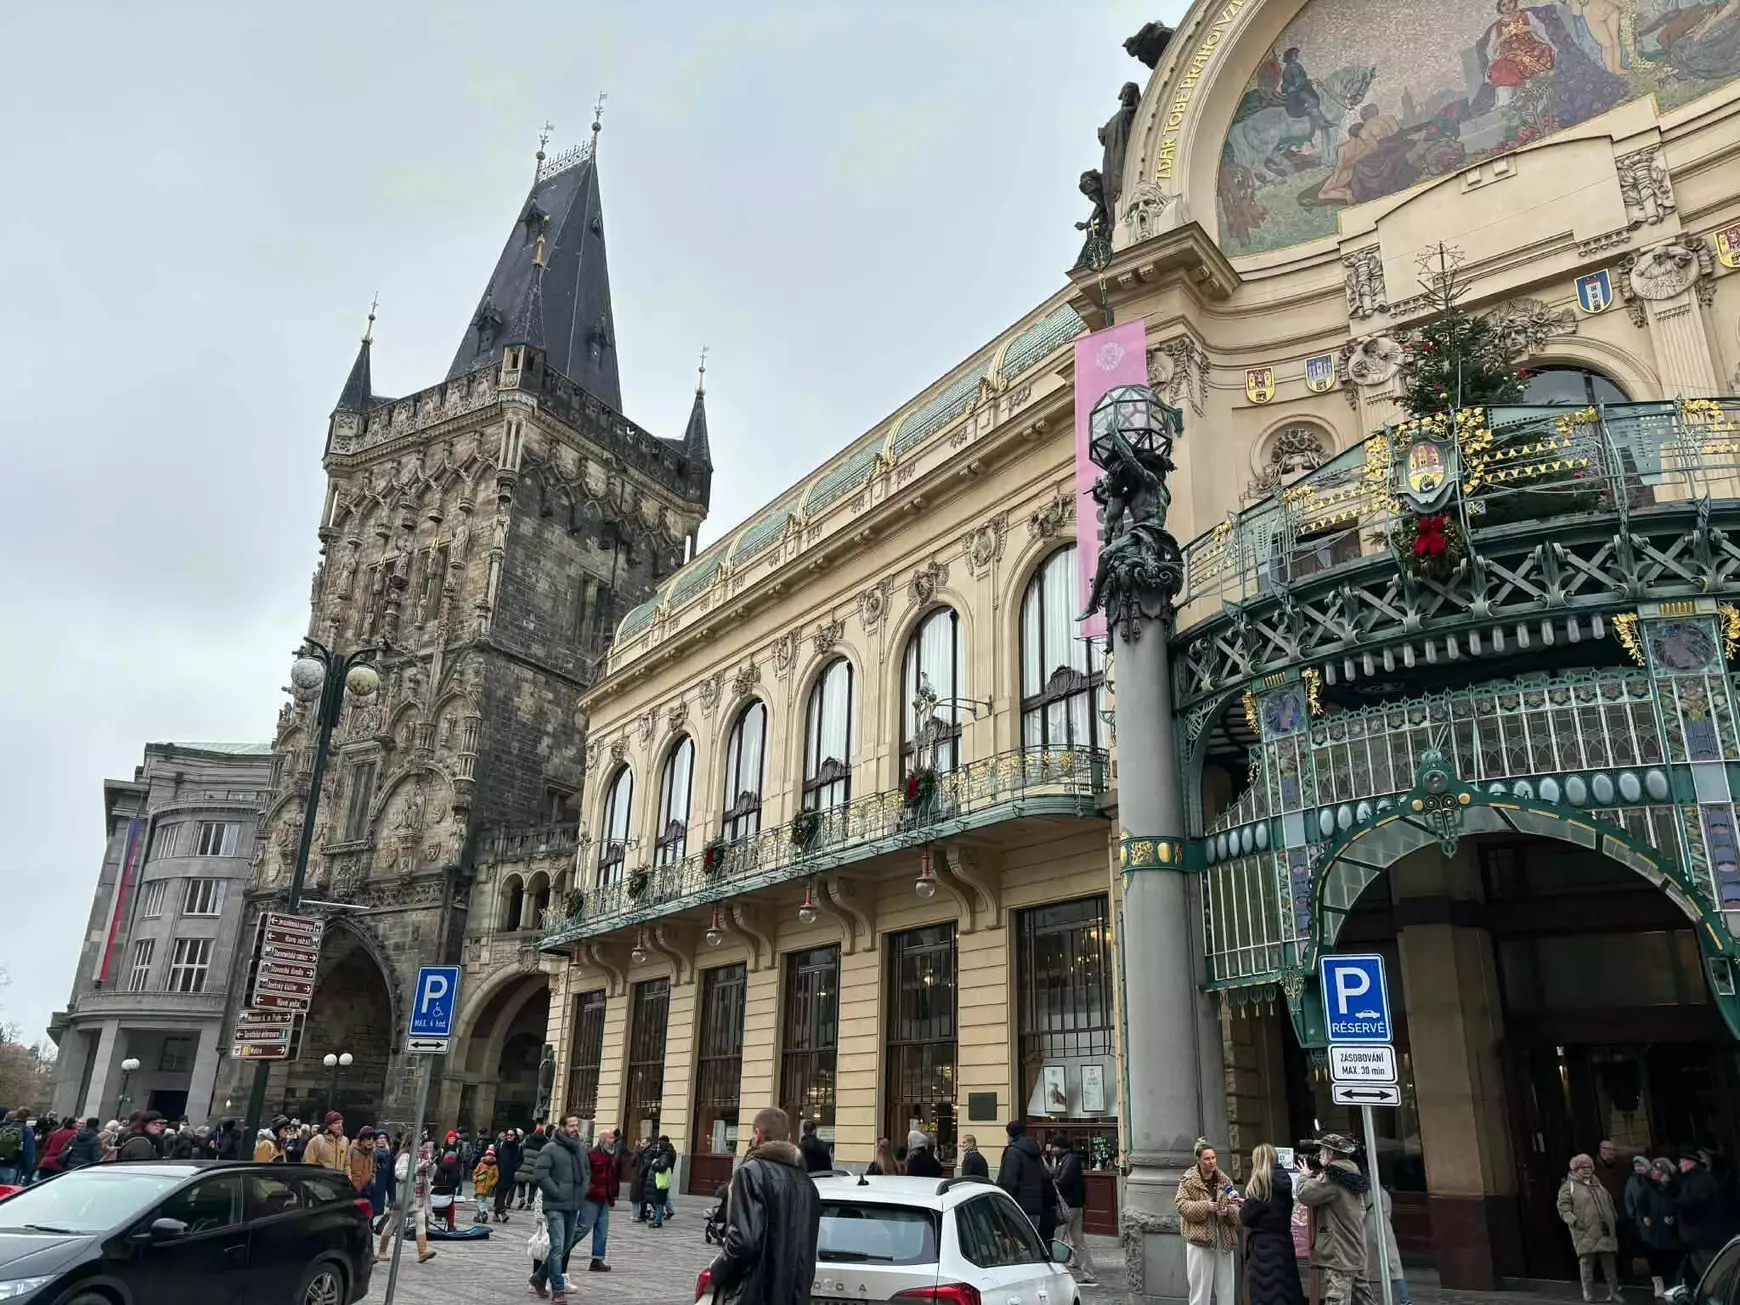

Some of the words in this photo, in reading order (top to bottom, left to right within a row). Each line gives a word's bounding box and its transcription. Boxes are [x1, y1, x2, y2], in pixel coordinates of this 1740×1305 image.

[421, 975, 448, 1014] P
[1334, 967, 1371, 1015] P
[1332, 1020, 1385, 1034] RÉSERVÉ
[1340, 1052, 1384, 1063] ZÁSOBOVÁNÍ
[1342, 1065, 1360, 1075] MAX.
[1361, 1066, 1370, 1075] 30
[1372, 1066, 1385, 1075] min
